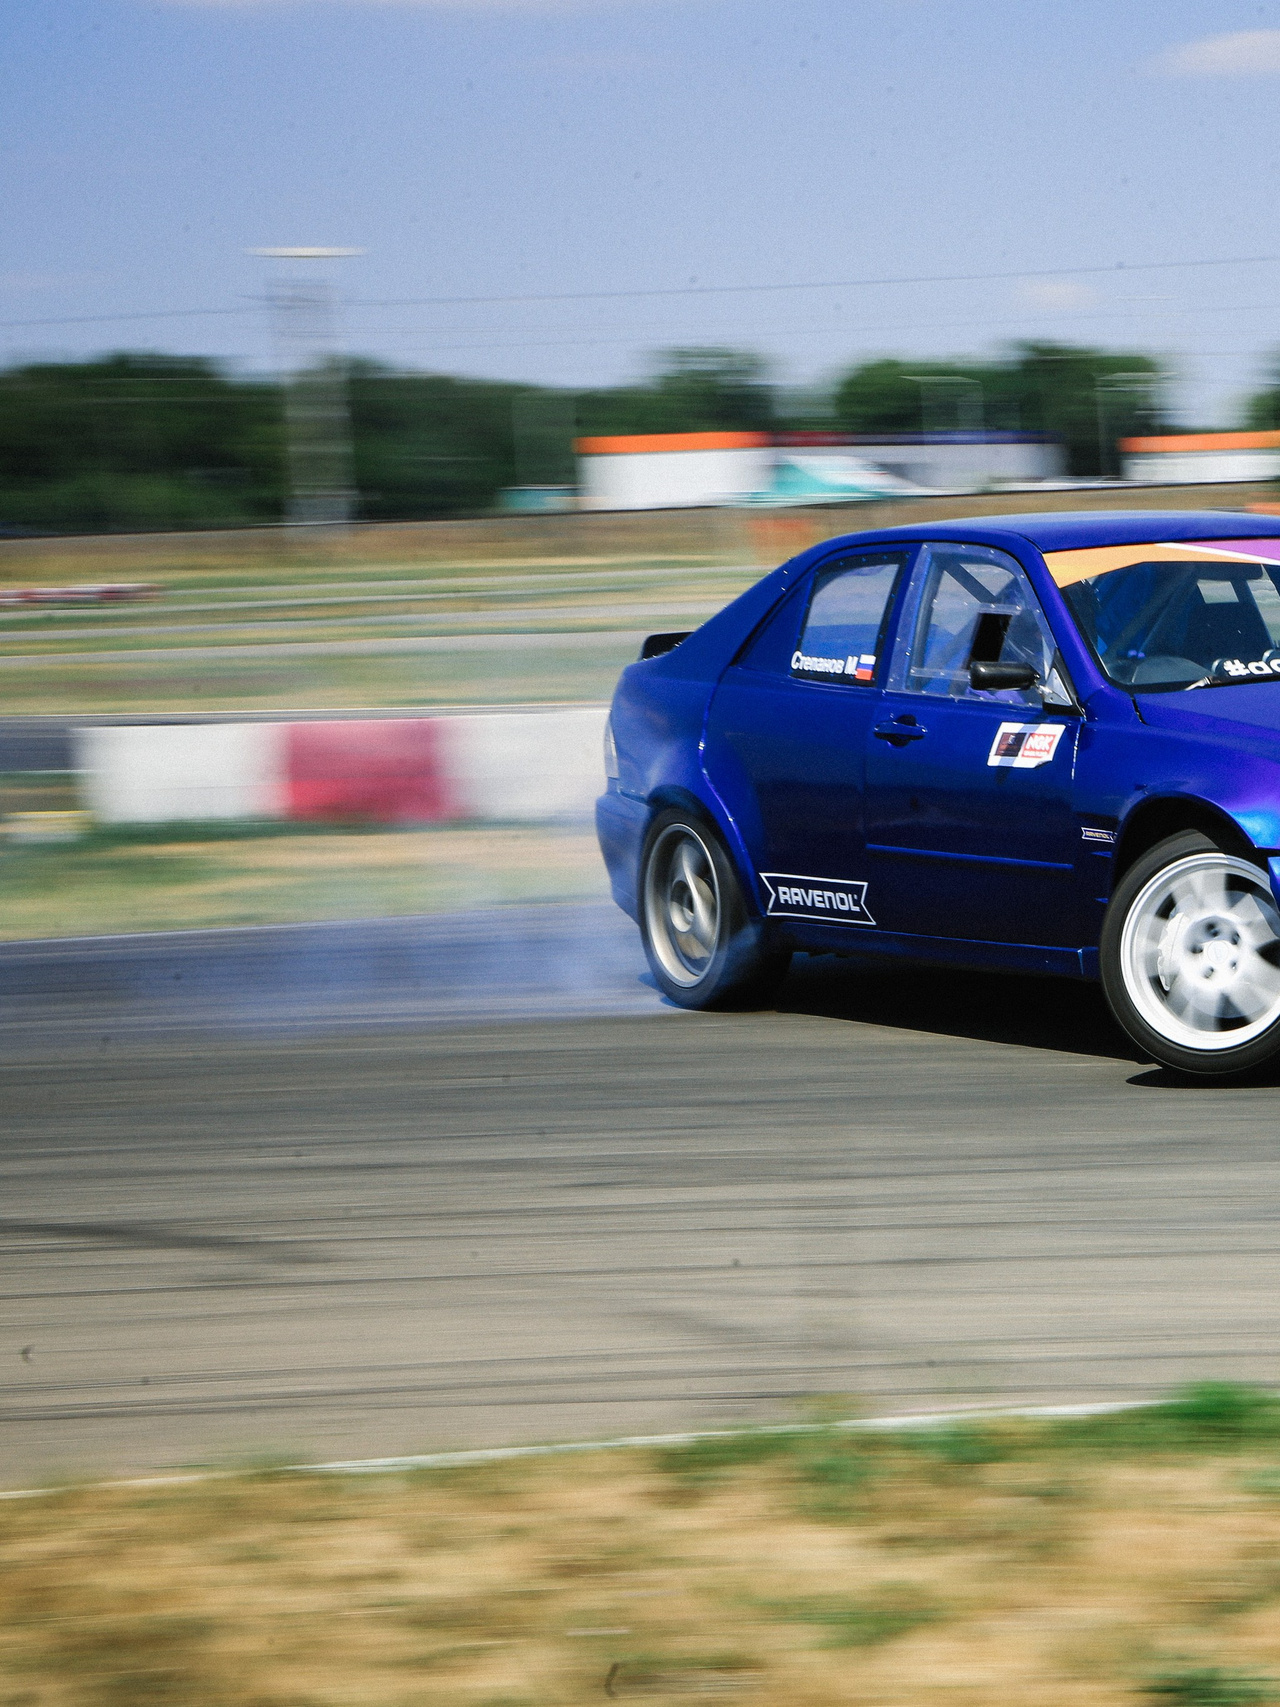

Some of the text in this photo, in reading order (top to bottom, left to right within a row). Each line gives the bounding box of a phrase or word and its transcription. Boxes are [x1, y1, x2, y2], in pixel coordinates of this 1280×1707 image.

[791, 650, 845, 674] Степанов
[1025, 735, 1054, 751] NGK
[777, 886, 861, 912] RAVENOL
